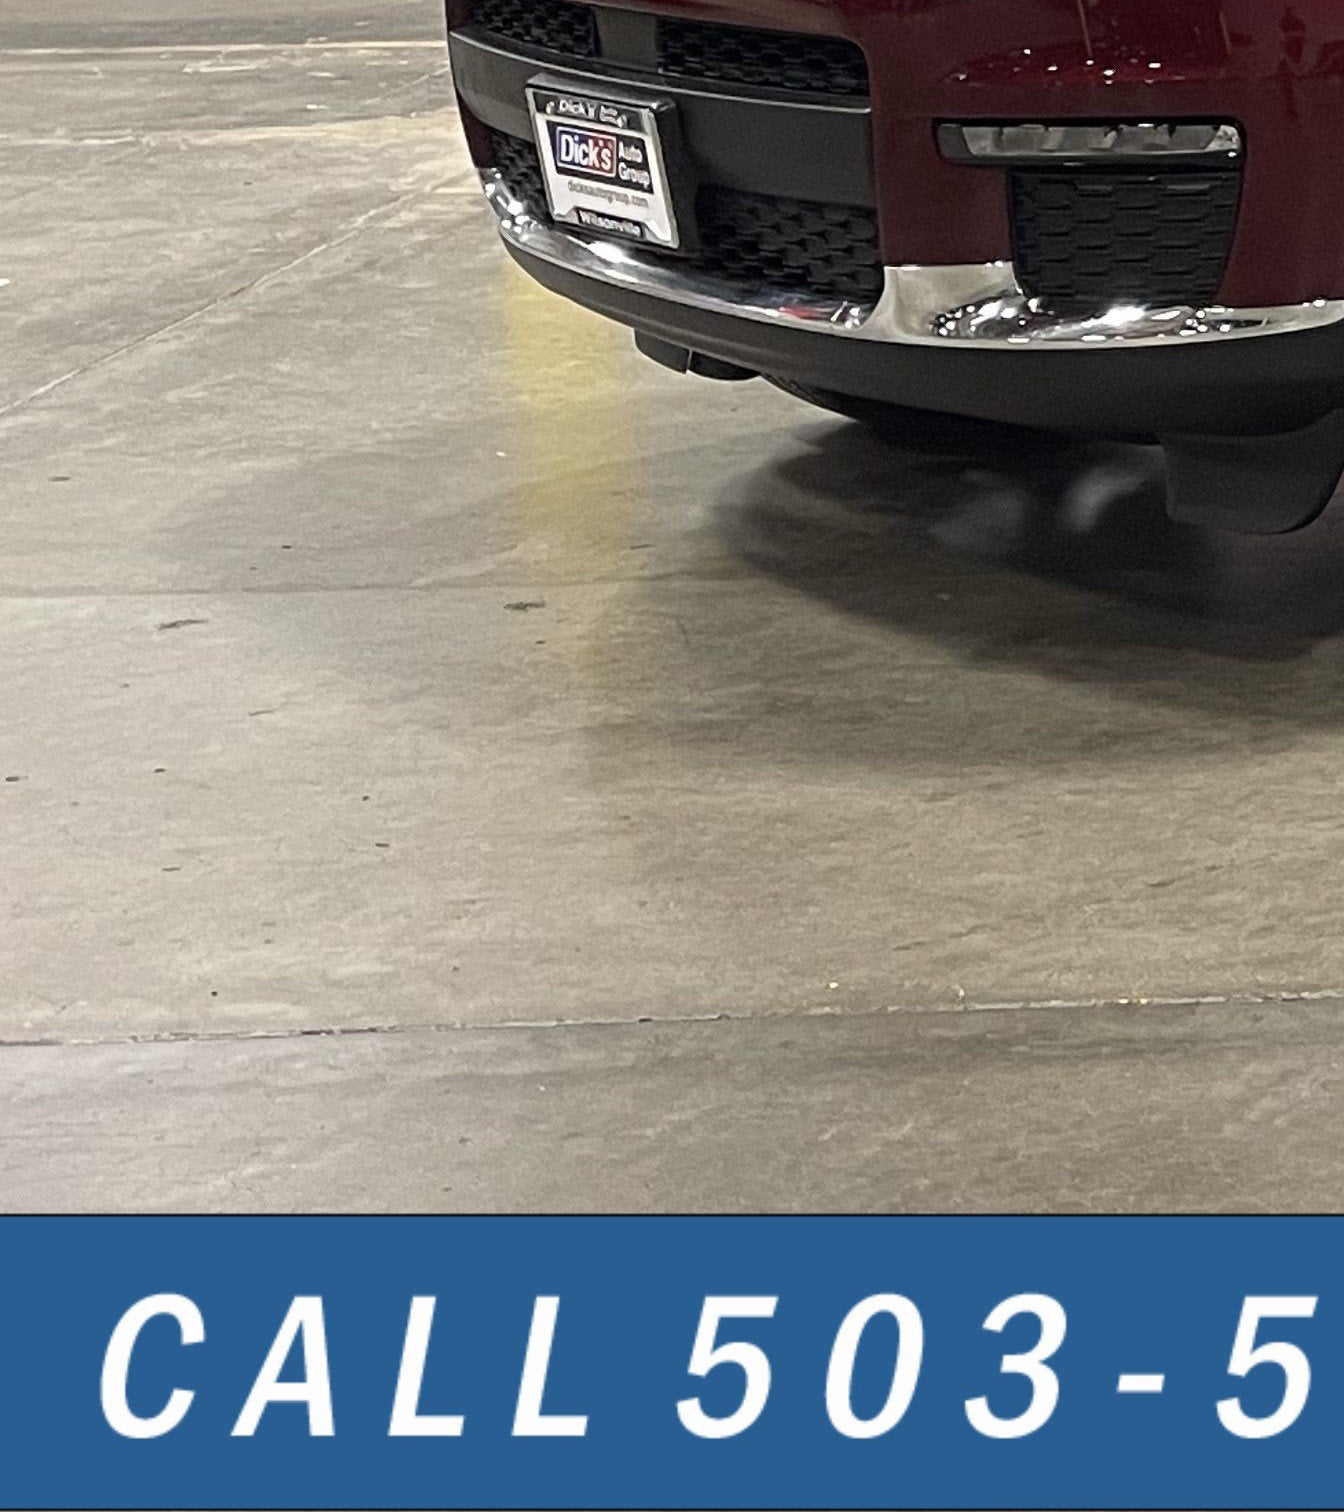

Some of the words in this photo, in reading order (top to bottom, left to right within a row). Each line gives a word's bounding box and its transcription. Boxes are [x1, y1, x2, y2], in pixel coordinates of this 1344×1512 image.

[560, 134, 612, 171] Dick's
[618, 140, 643, 164] Auto
[617, 162, 650, 189] Group
